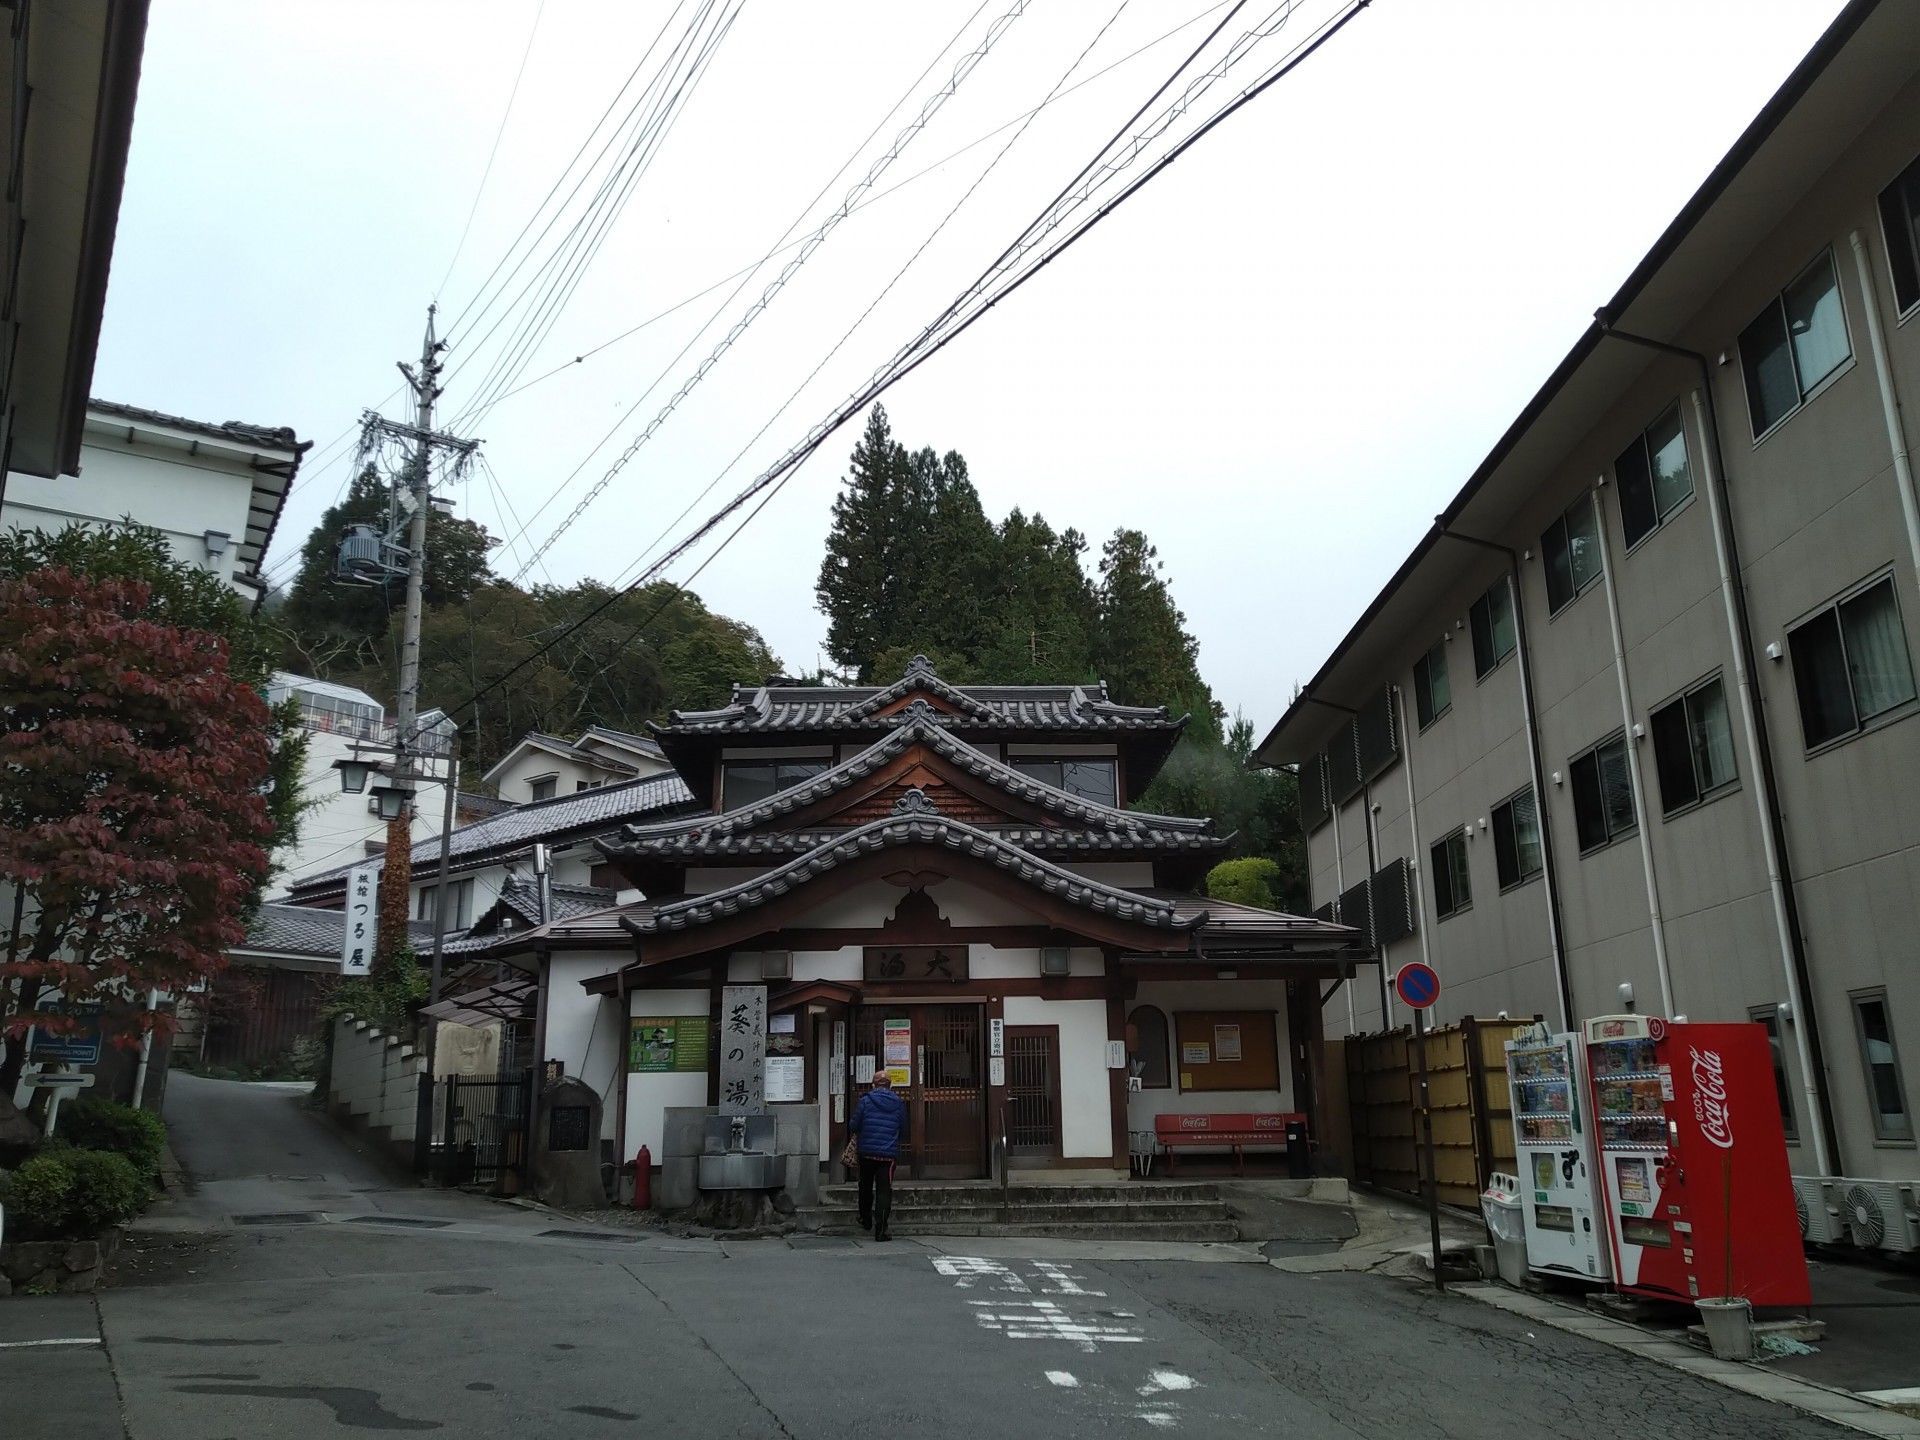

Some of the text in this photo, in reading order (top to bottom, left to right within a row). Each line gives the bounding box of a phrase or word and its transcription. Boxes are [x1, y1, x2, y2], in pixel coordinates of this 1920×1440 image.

[725, 1002, 751, 1106] 葵の湯
[992, 1020, 1002, 1055] 警察官立寄所
[1689, 1044, 1734, 1149] Coca-Cola
